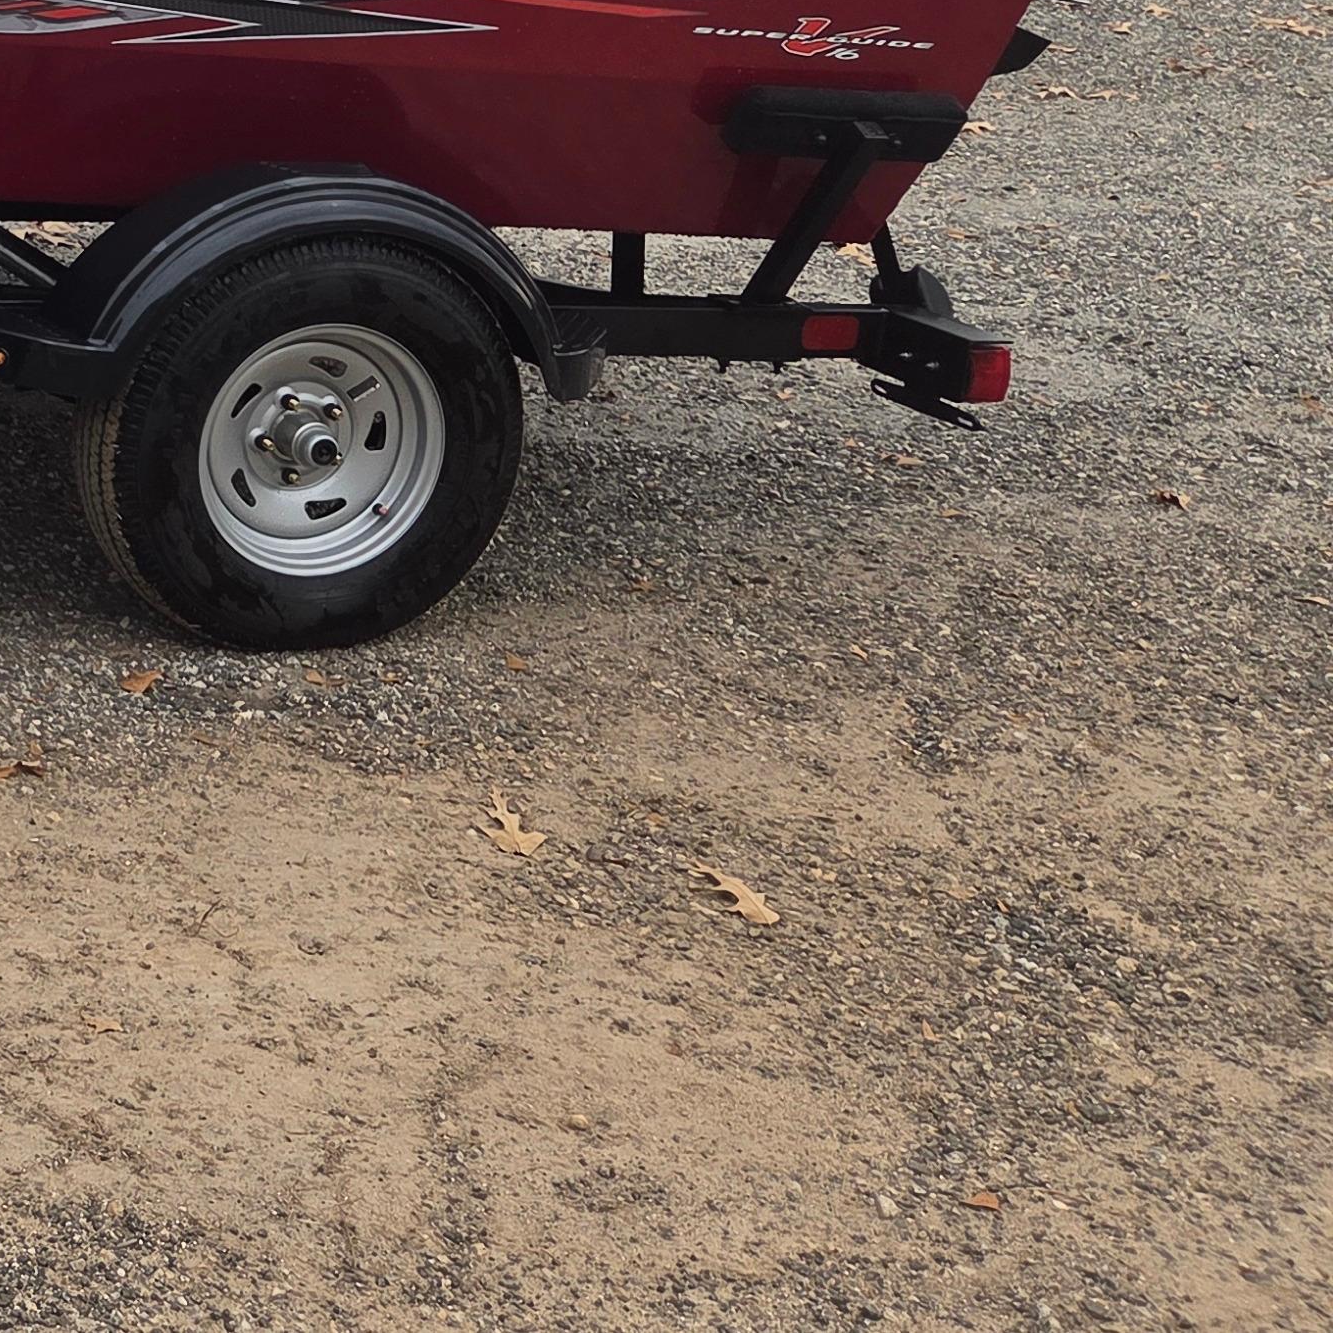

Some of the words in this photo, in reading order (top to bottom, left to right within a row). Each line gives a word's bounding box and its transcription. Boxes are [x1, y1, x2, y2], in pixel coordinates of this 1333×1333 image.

[692, 26, 812, 41] SUPER
[832, 35, 935, 50] GUIDE
[825, 47, 860, 61] 16
